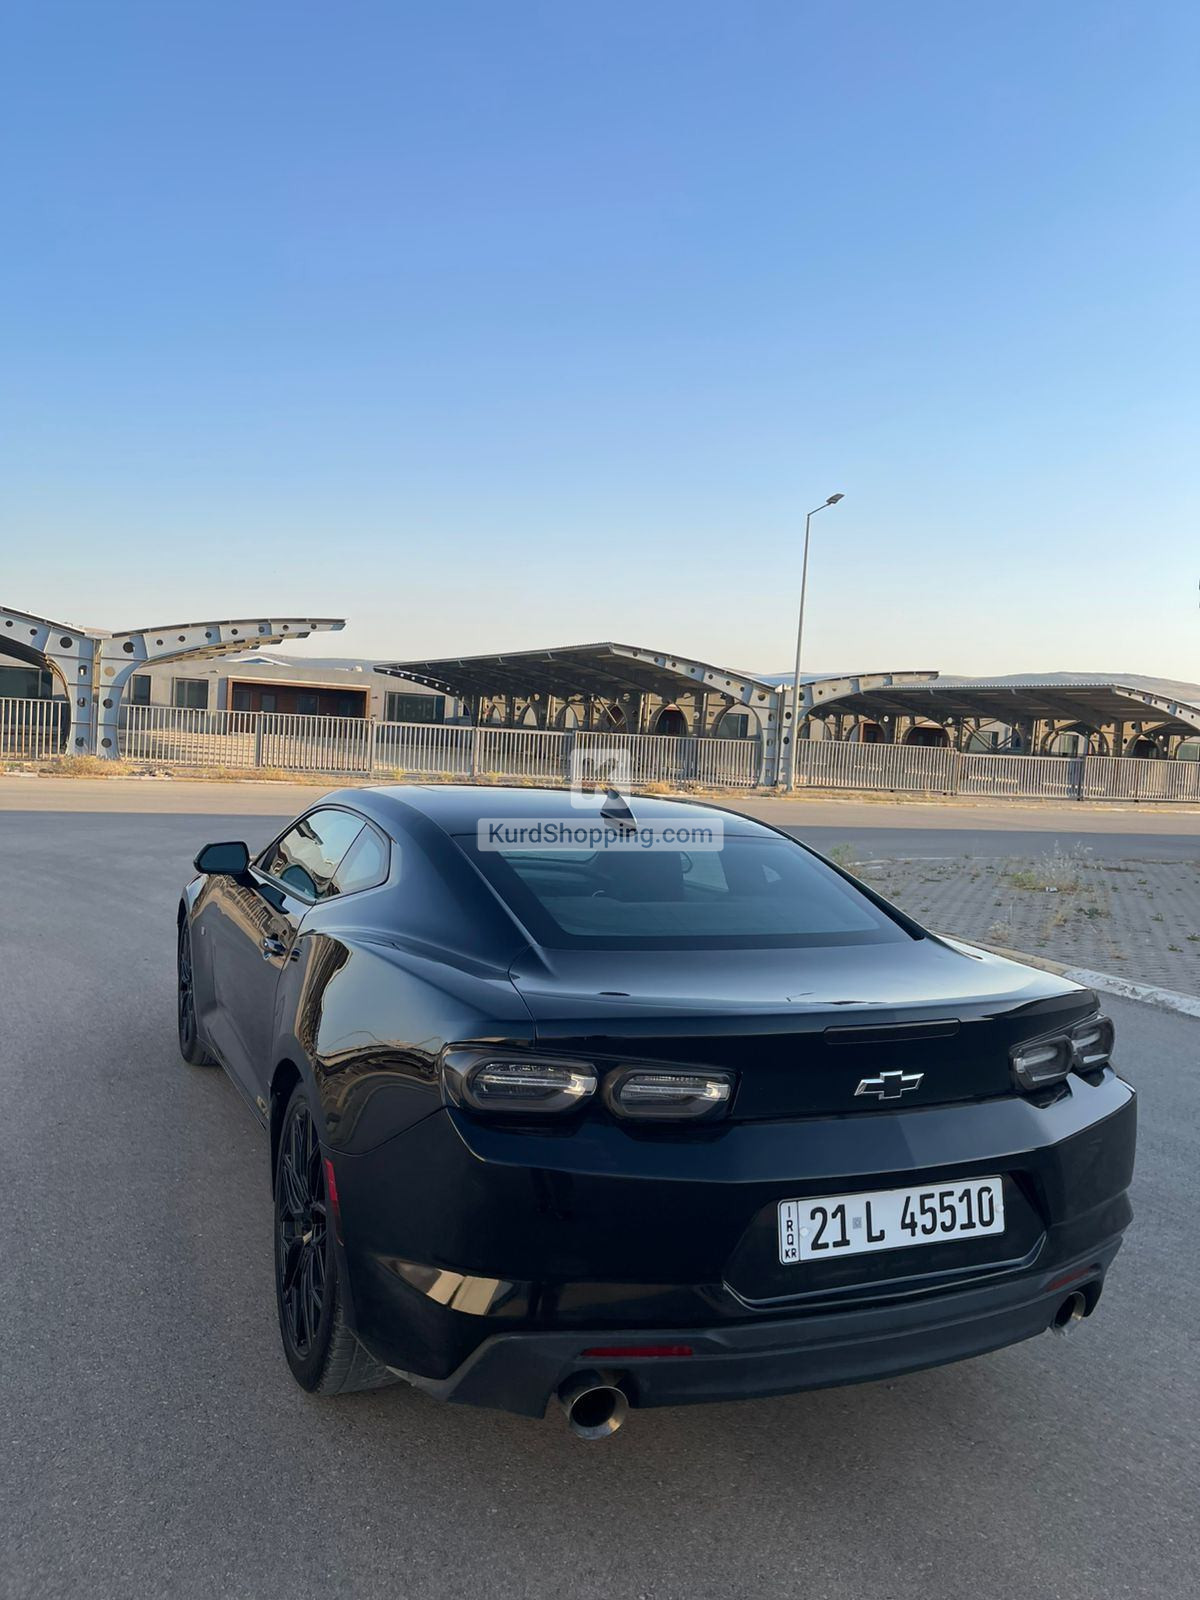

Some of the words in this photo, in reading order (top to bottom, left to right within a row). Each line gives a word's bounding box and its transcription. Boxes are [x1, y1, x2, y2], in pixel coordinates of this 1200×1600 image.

[786, 1205, 794, 1246] IRQ
[810, 1204, 850, 1251] 21
[865, 1201, 885, 1243] L
[901, 1186, 995, 1237] 45510
[785, 1248, 797, 1259] KR
